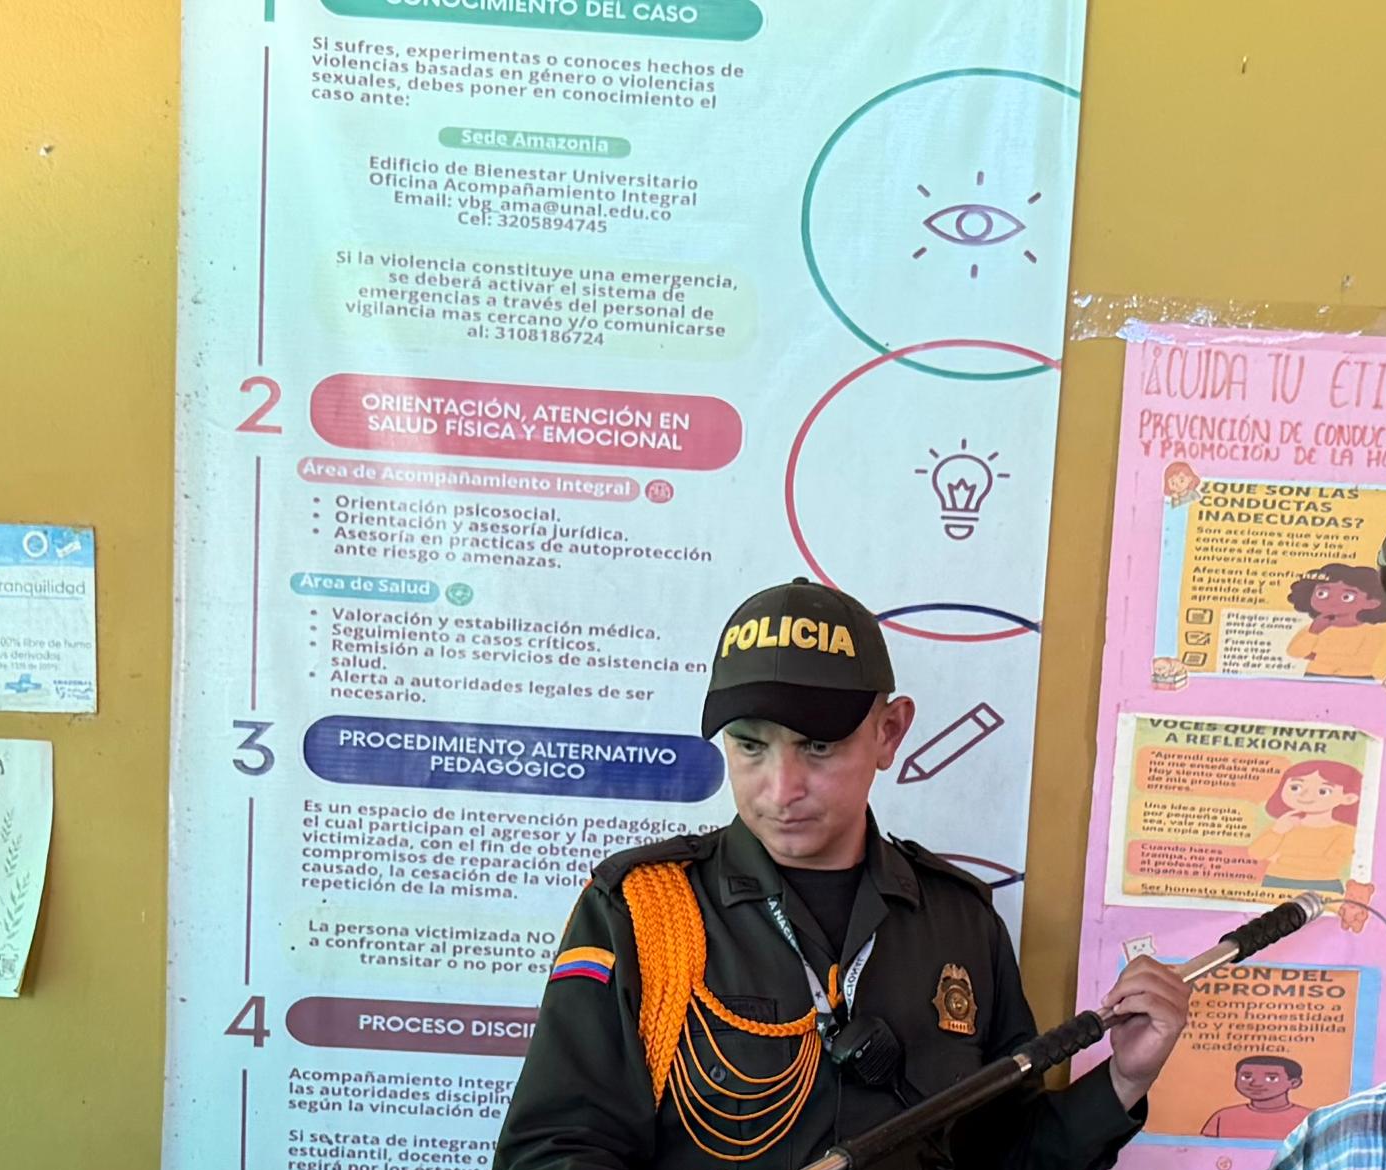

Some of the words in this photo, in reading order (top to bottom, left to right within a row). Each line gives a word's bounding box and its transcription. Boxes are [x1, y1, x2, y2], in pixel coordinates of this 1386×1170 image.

[386, 0, 576, 17] OCIMIENTO
[585, 1, 625, 20] DEL
[632, 5, 698, 24] CASO
[313, 36, 327, 51] Si
[334, 38, 399, 59] sufres,
[406, 42, 540, 68] experimentas
[547, 55, 557, 65] o
[564, 56, 640, 71] conoces
[647, 58, 714, 76] hechos
[721, 63, 743, 78] de
[461, 130, 508, 146] Sede
[370, 155, 438, 173] Edificio
[445, 160, 467, 175] de
[475, 162, 566, 181] Bienestar
[573, 168, 697, 190] Universitario
[369, 171, 437, 189] Oficina
[443, 176, 615, 204] Acompañamiento
[622, 187, 696, 210] Integral
[394, 189, 451, 206] Email:
[458, 193, 671, 224] vbg_ama@unal.edu.co
[458, 210, 491, 225] Cel:
[497, 212, 606, 230] 3205894745
[467, 323, 488, 337] al:
[495, 324, 603, 342] 3108186724
[1268, 352, 1306, 405] TU
[235, 376, 282, 434] 2
[362, 389, 526, 421] ORIENTACIÓN,
[533, 400, 651, 427] ATENCIÓN
[659, 413, 689, 430] EN
[369, 414, 437, 434] SALUD
[445, 418, 515, 440] FÍSICA
[521, 425, 536, 440] Y
[543, 425, 682, 450] EMOCIONAL
[1139, 408, 1271, 444] PREVENCIÓN
[1280, 421, 1302, 445] DE
[1160, 439, 1280, 462] PROMOCIÓN
[1295, 445, 1316, 466] DE
[1330, 448, 1354, 466] LA
[352, 462, 376, 478] de
[381, 464, 551, 494] Acompañamiento
[556, 475, 630, 499] Integral
[1265, 485, 1310, 497] SON
[1319, 487, 1359, 499] LAS
[335, 493, 446, 514] Orientación
[454, 501, 560, 525] psicosocial.
[1199, 496, 1332, 513] CONDUCTAS
[1198, 510, 1364, 529] INADECUADAS?
[350, 575, 373, 590] de
[378, 579, 430, 595] Salud
[332, 606, 432, 626] Valoración
[438, 617, 448, 631] y
[454, 614, 582, 635] estabilización
[588, 622, 660, 640] médica.
[332, 622, 449, 646] Seguimiento
[455, 633, 465, 643] a
[471, 634, 522, 646] casos
[528, 633, 600, 651] críticos.
[720, 614, 855, 660] POLICIA
[331, 683, 425, 702] necesario.
[1150, 718, 1217, 732] VOCES
[1224, 723, 1269, 736] QUE
[1273, 726, 1357, 741] INVITAN
[232, 719, 275, 776] 3
[339, 730, 524, 755] PROCEDIMIENTO
[531, 740, 676, 764] ALTERNATIVO
[1165, 733, 1178, 743] A
[1186, 733, 1327, 754] REFLEXIONAR
[430, 751, 584, 779] PEDAGÓGICO
[301, 873, 395, 896] repetición
[401, 878, 423, 893] de
[429, 880, 444, 894] la
[451, 881, 517, 898] misma.
[309, 918, 328, 933] La
[334, 923, 408, 940] persona
[415, 923, 520, 942] victimizada
[527, 928, 555, 943] NO
[1281, 969, 1333, 982] DEL
[1207, 1001, 1325, 1012] comprometo
[1244, 1011, 1344, 1023] honestidad
[224, 996, 270, 1048] 4
[359, 1014, 465, 1035] PROCESO
[1192, 1042, 1290, 1053] académica.
[1227, 1032, 1315, 1042] formación
[289, 1095, 341, 1115] según
[348, 1098, 363, 1112] la
[369, 1099, 473, 1117] vinculación
[479, 1104, 500, 1118] de
